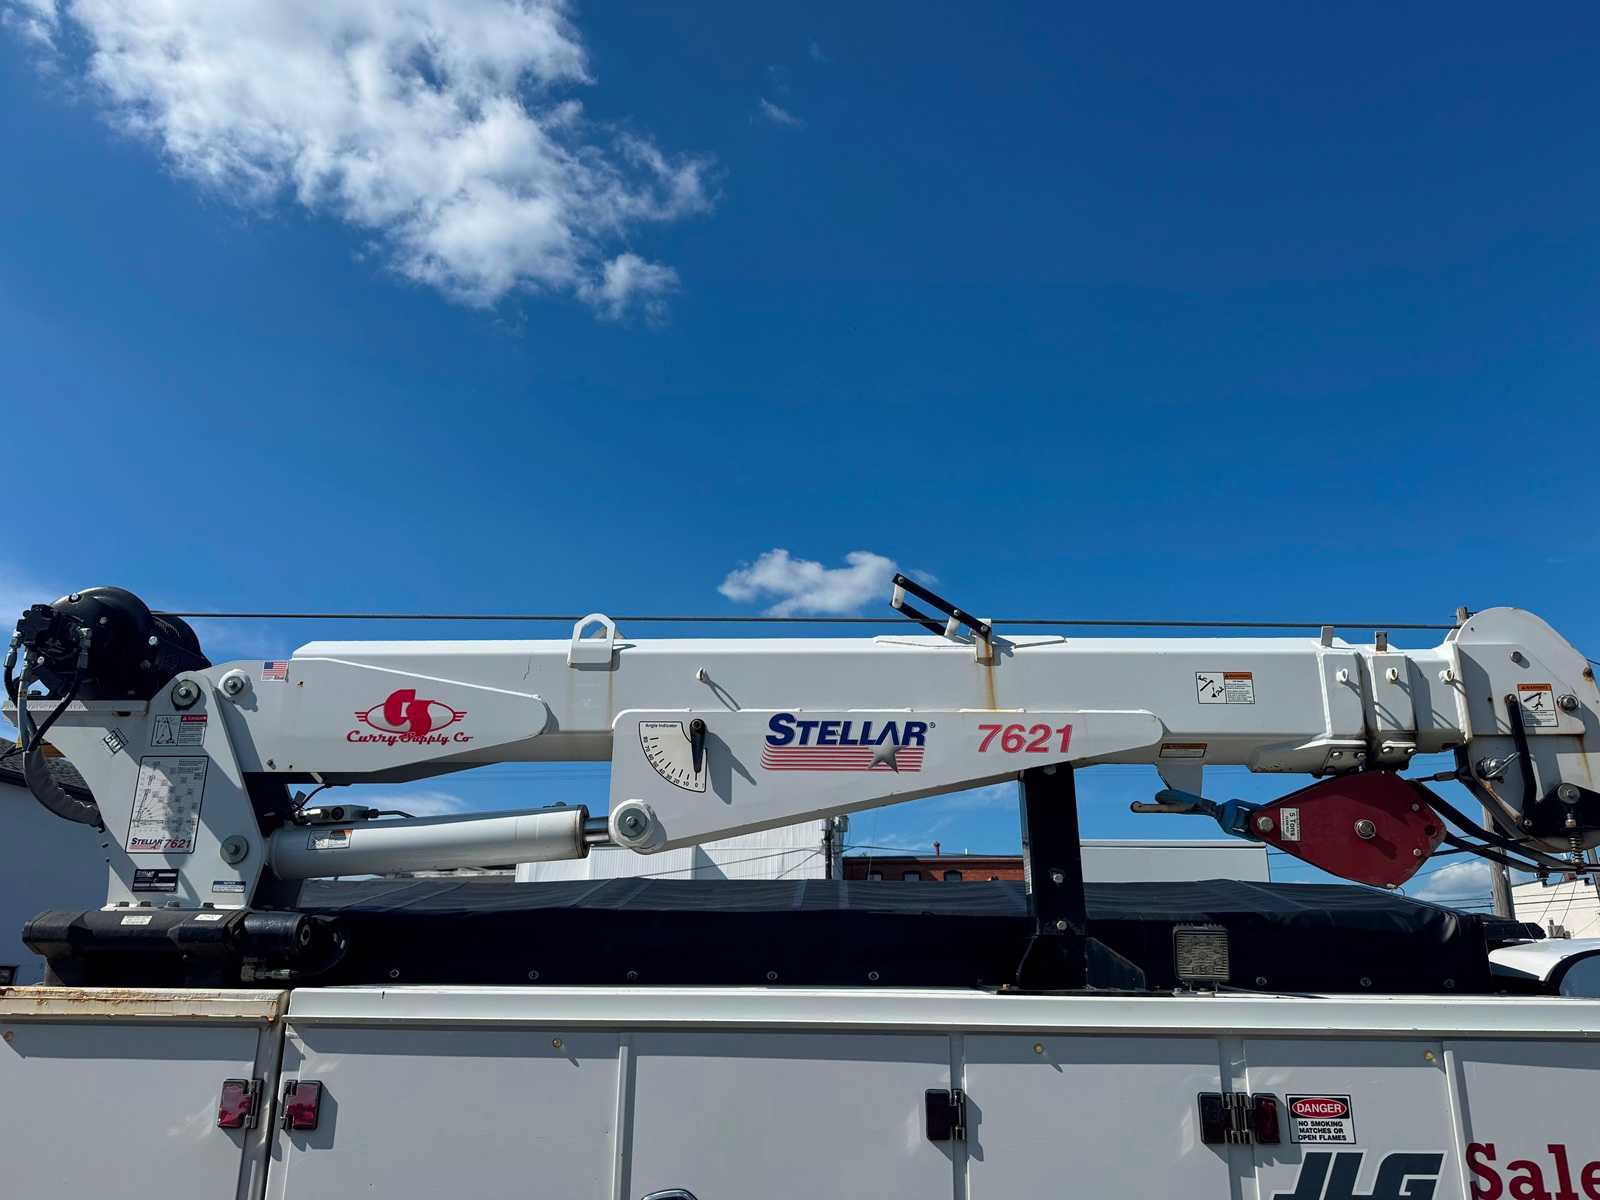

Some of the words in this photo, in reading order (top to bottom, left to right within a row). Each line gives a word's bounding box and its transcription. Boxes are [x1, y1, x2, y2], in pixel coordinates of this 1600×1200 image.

[347, 730, 398, 746] Curry
[765, 712, 928, 746] STELLAR
[978, 724, 1073, 753] 7621
[163, 839, 193, 849] 7621
[1296, 1103, 1342, 1113] DANGER
[1273, 1151, 1446, 1200] JLG
